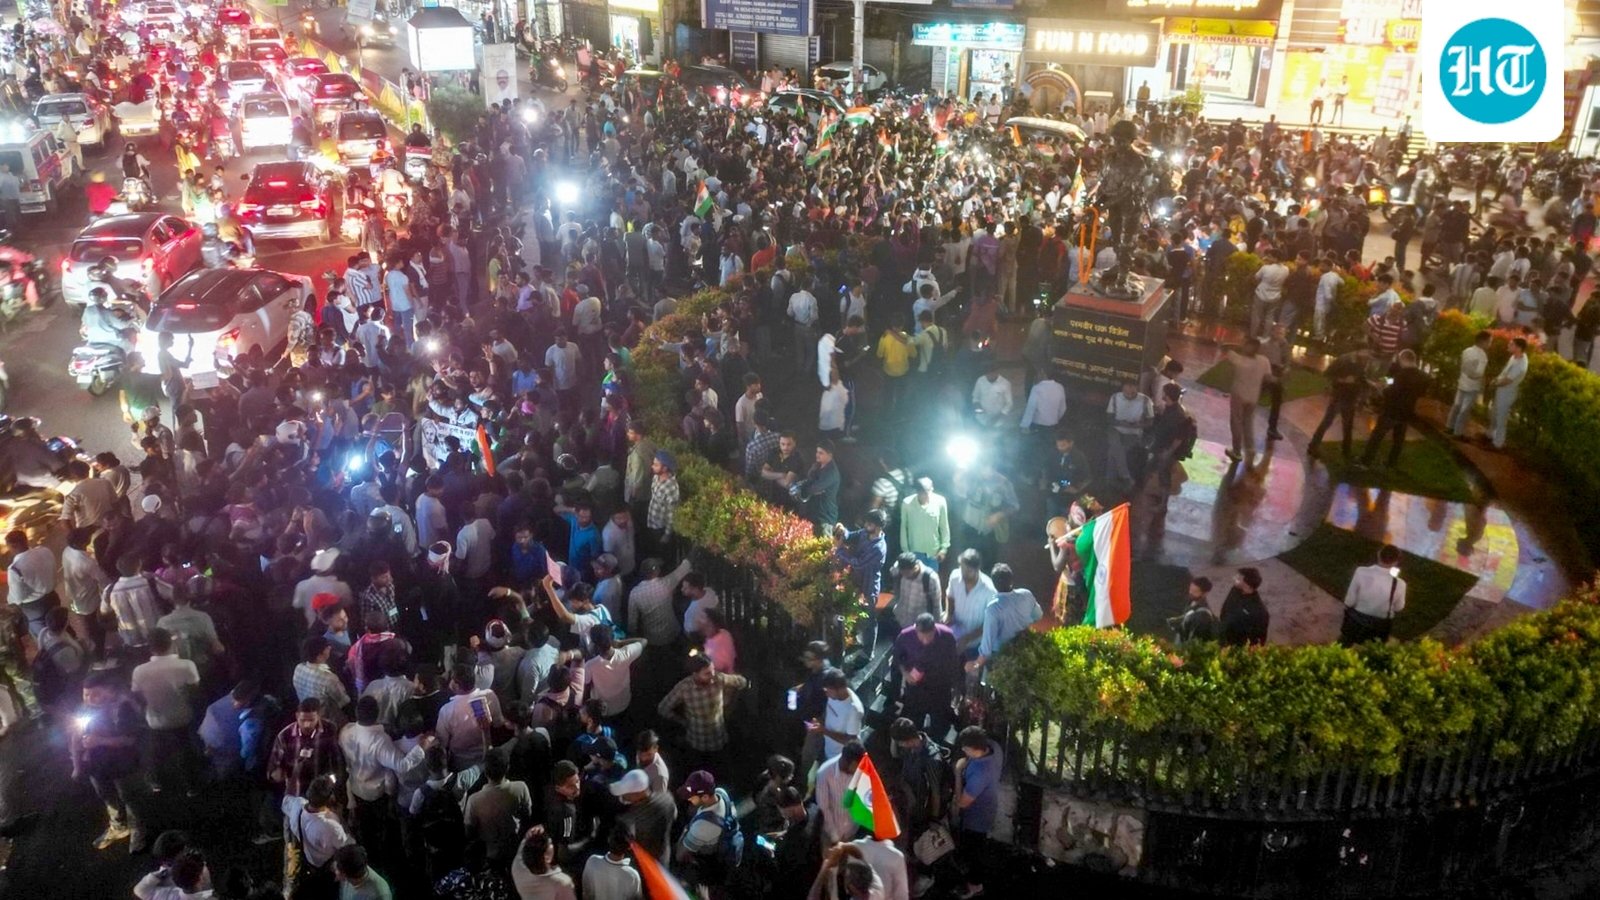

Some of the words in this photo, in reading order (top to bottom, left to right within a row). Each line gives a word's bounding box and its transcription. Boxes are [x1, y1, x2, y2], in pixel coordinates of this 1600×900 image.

[1035, 29, 1074, 52] FUN
[1078, 31, 1094, 53] N
[1098, 32, 1149, 56] FOOD
[1167, 34, 1200, 42] GRAND
[1204, 35, 1243, 44] ANNUAL
[1245, 37, 1271, 46] SALE
